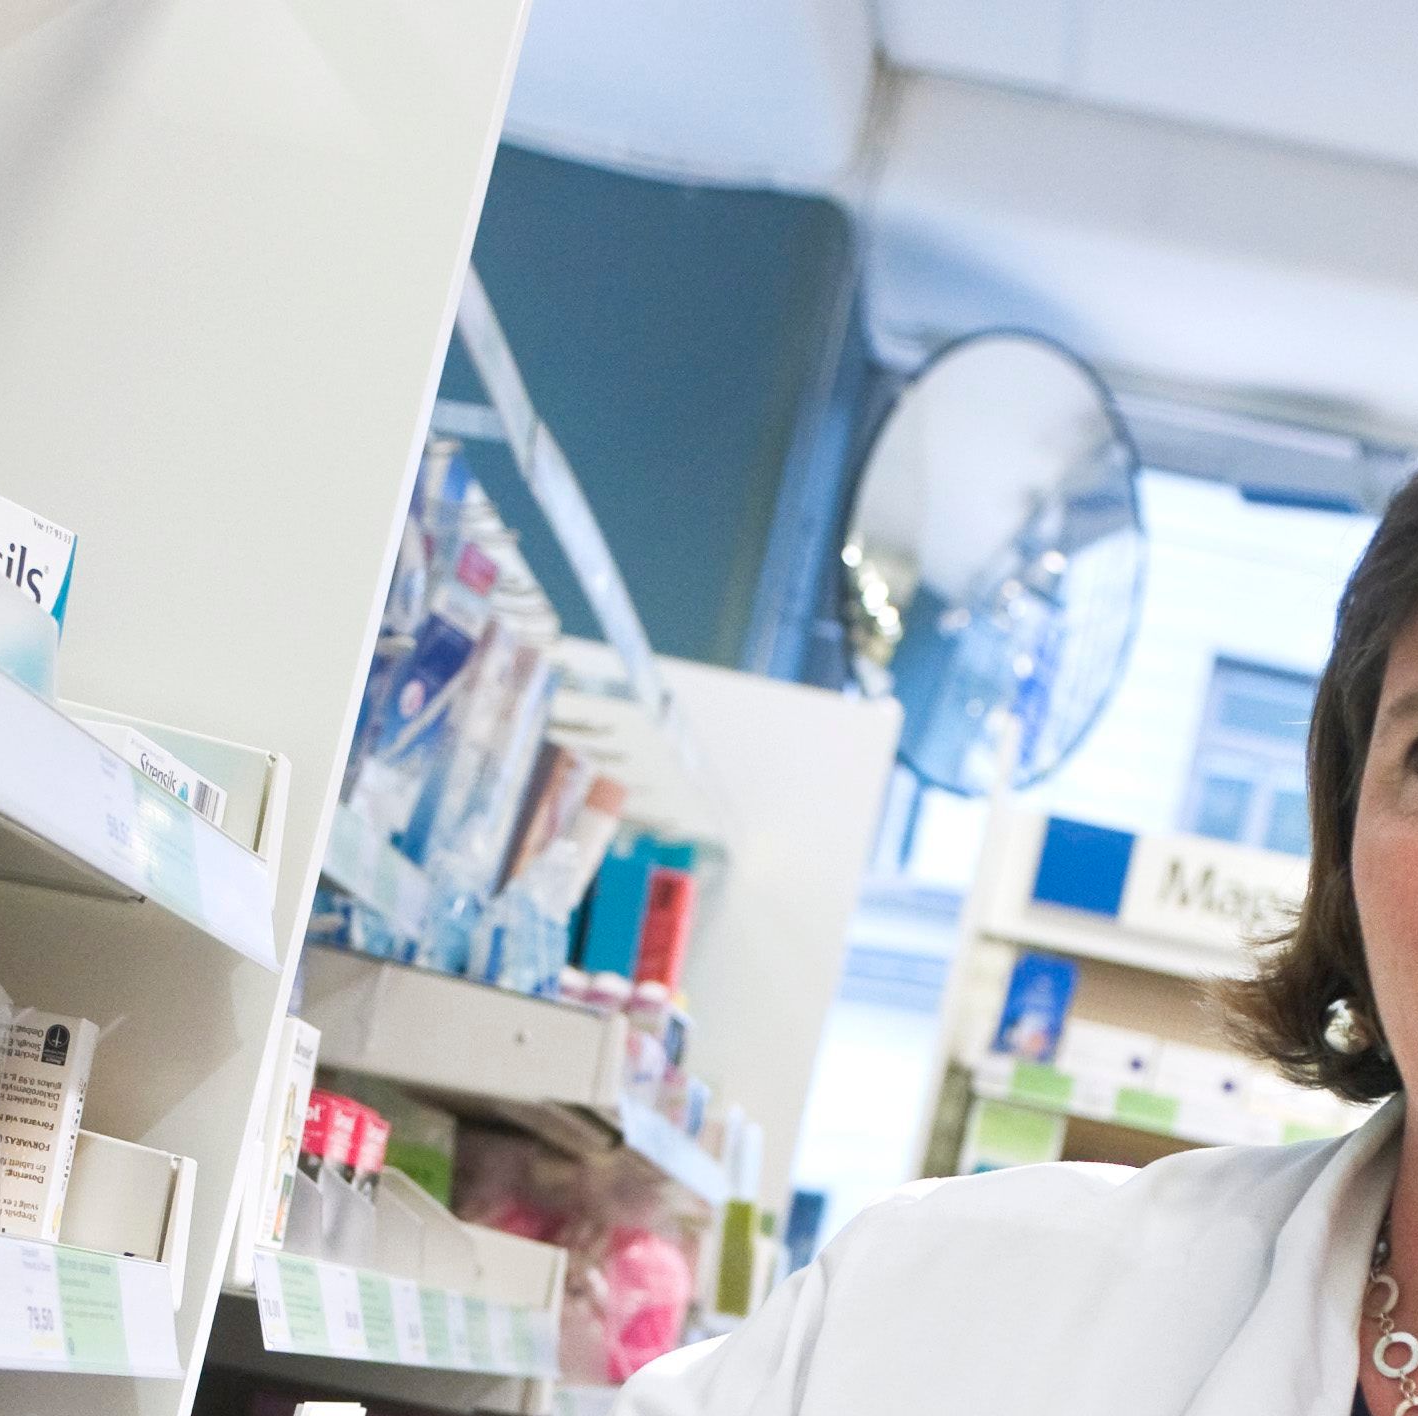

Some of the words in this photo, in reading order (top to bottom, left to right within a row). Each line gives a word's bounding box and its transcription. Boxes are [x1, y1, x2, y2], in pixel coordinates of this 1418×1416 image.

[6, 1114, 18, 1126] vid
[19, 1117, 55, 1131] Förvaras
[4, 1135, 51, 1152] FÖRVARAS
[4, 1208, 37, 1222] Strepsils
